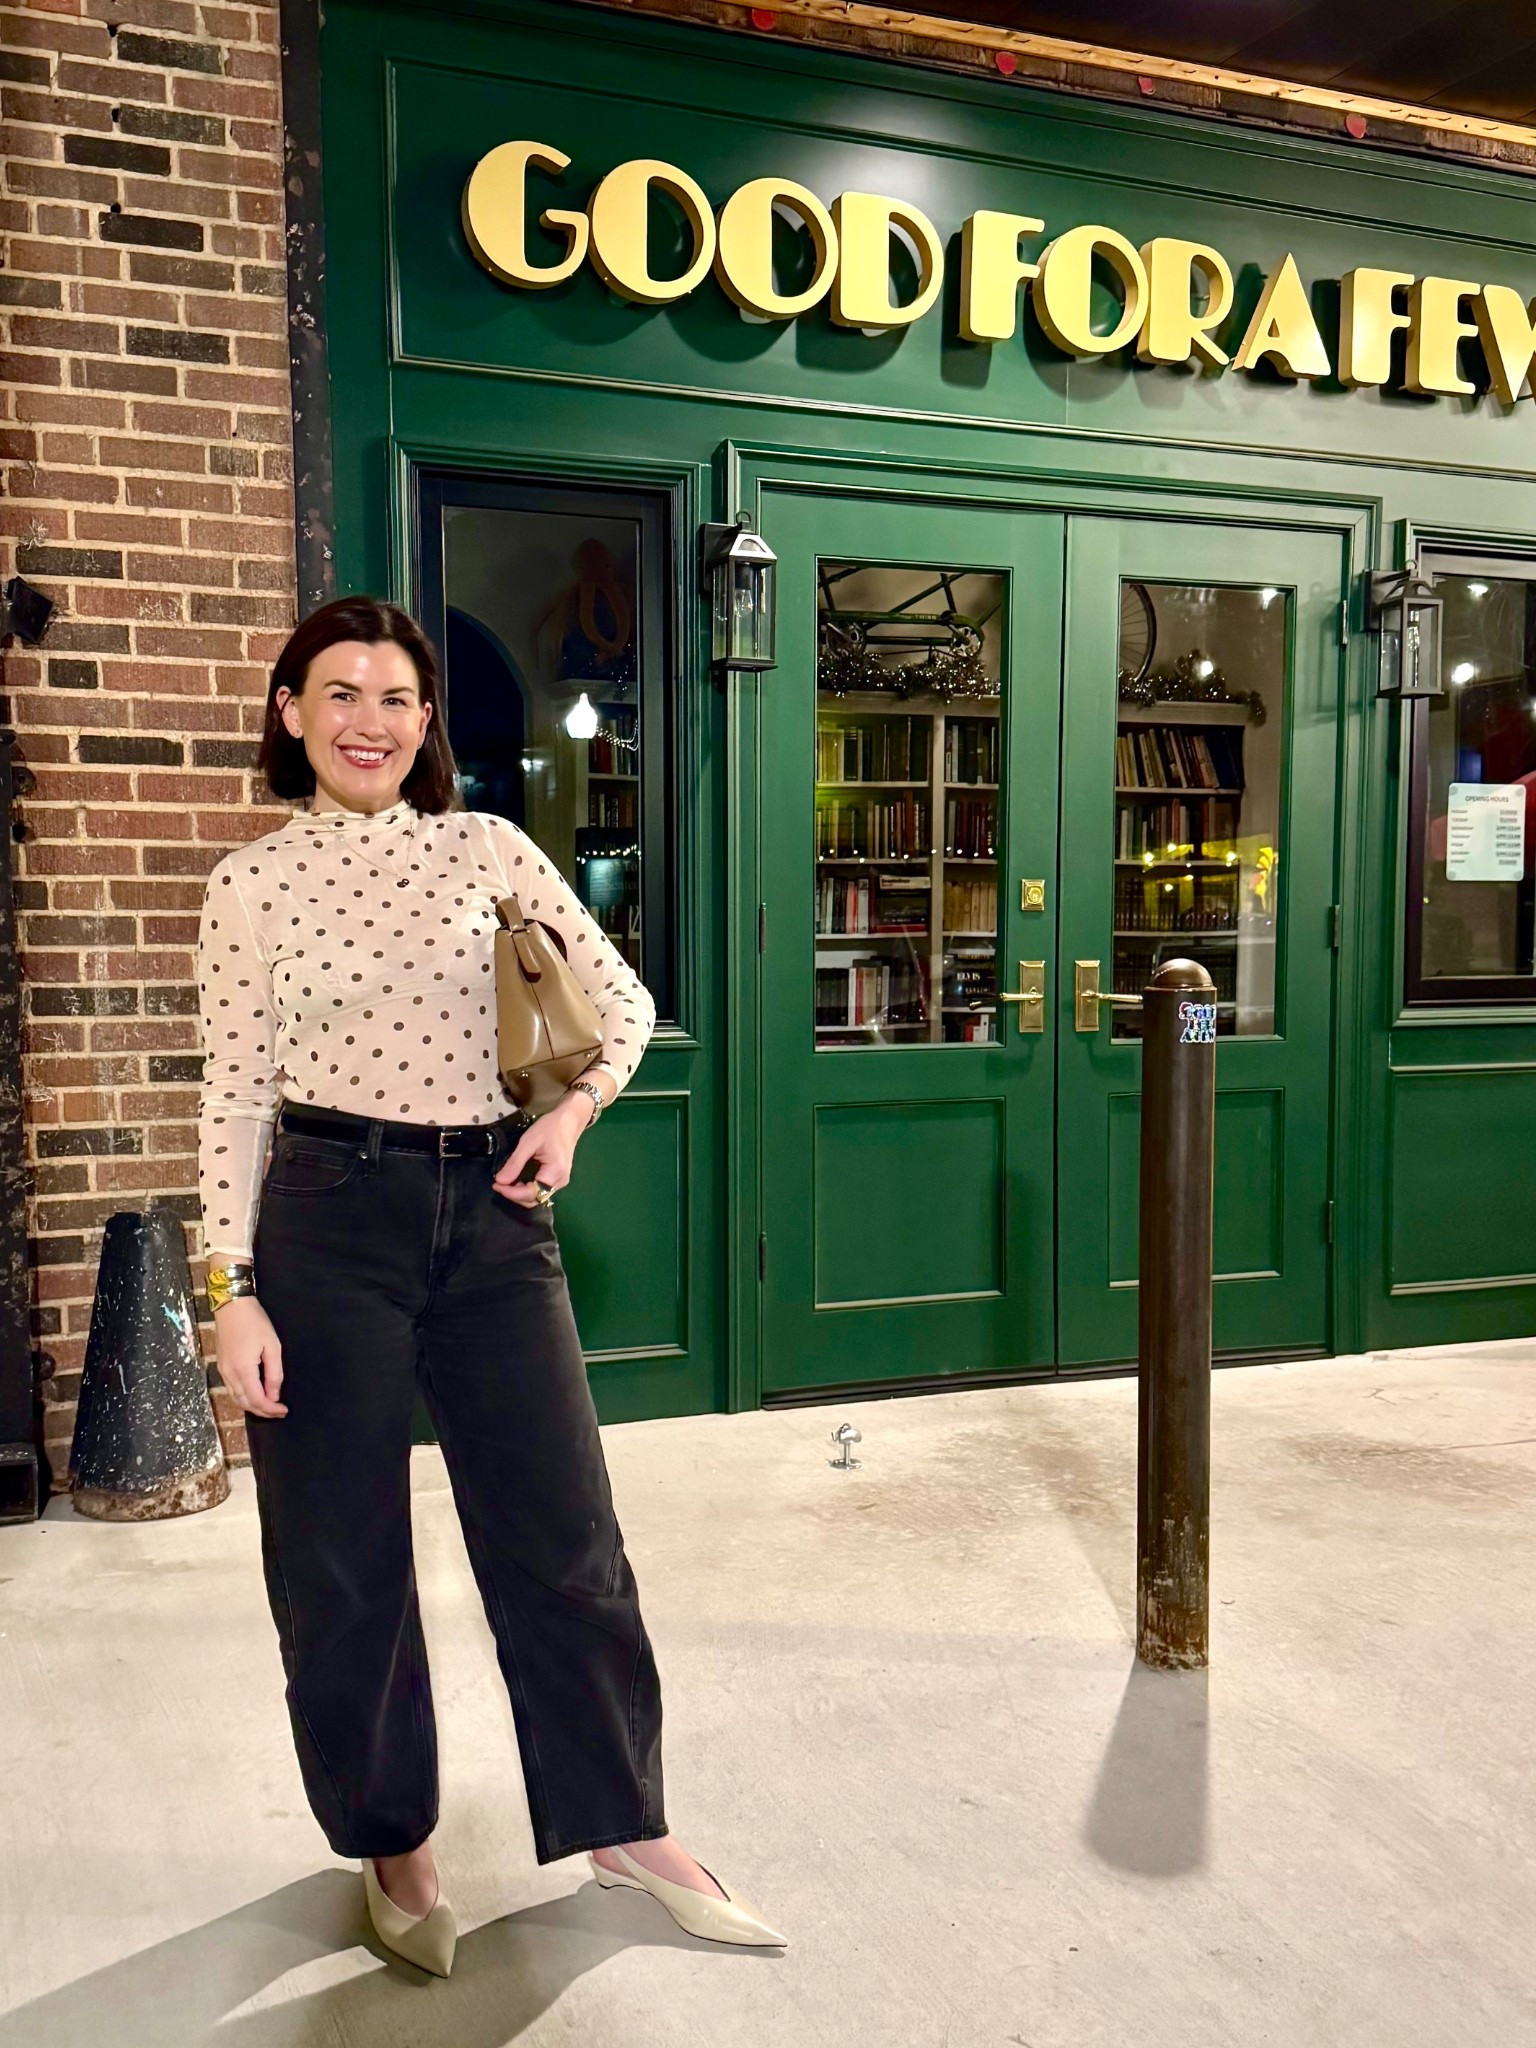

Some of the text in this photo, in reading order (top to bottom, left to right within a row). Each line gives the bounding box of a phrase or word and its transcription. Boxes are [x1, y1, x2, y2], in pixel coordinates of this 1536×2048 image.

[463, 141, 945, 329] GOOD
[960, 210, 1230, 366] FOR
[1232, 252, 1332, 380] A
[957, 972, 980, 981] ELVIS
